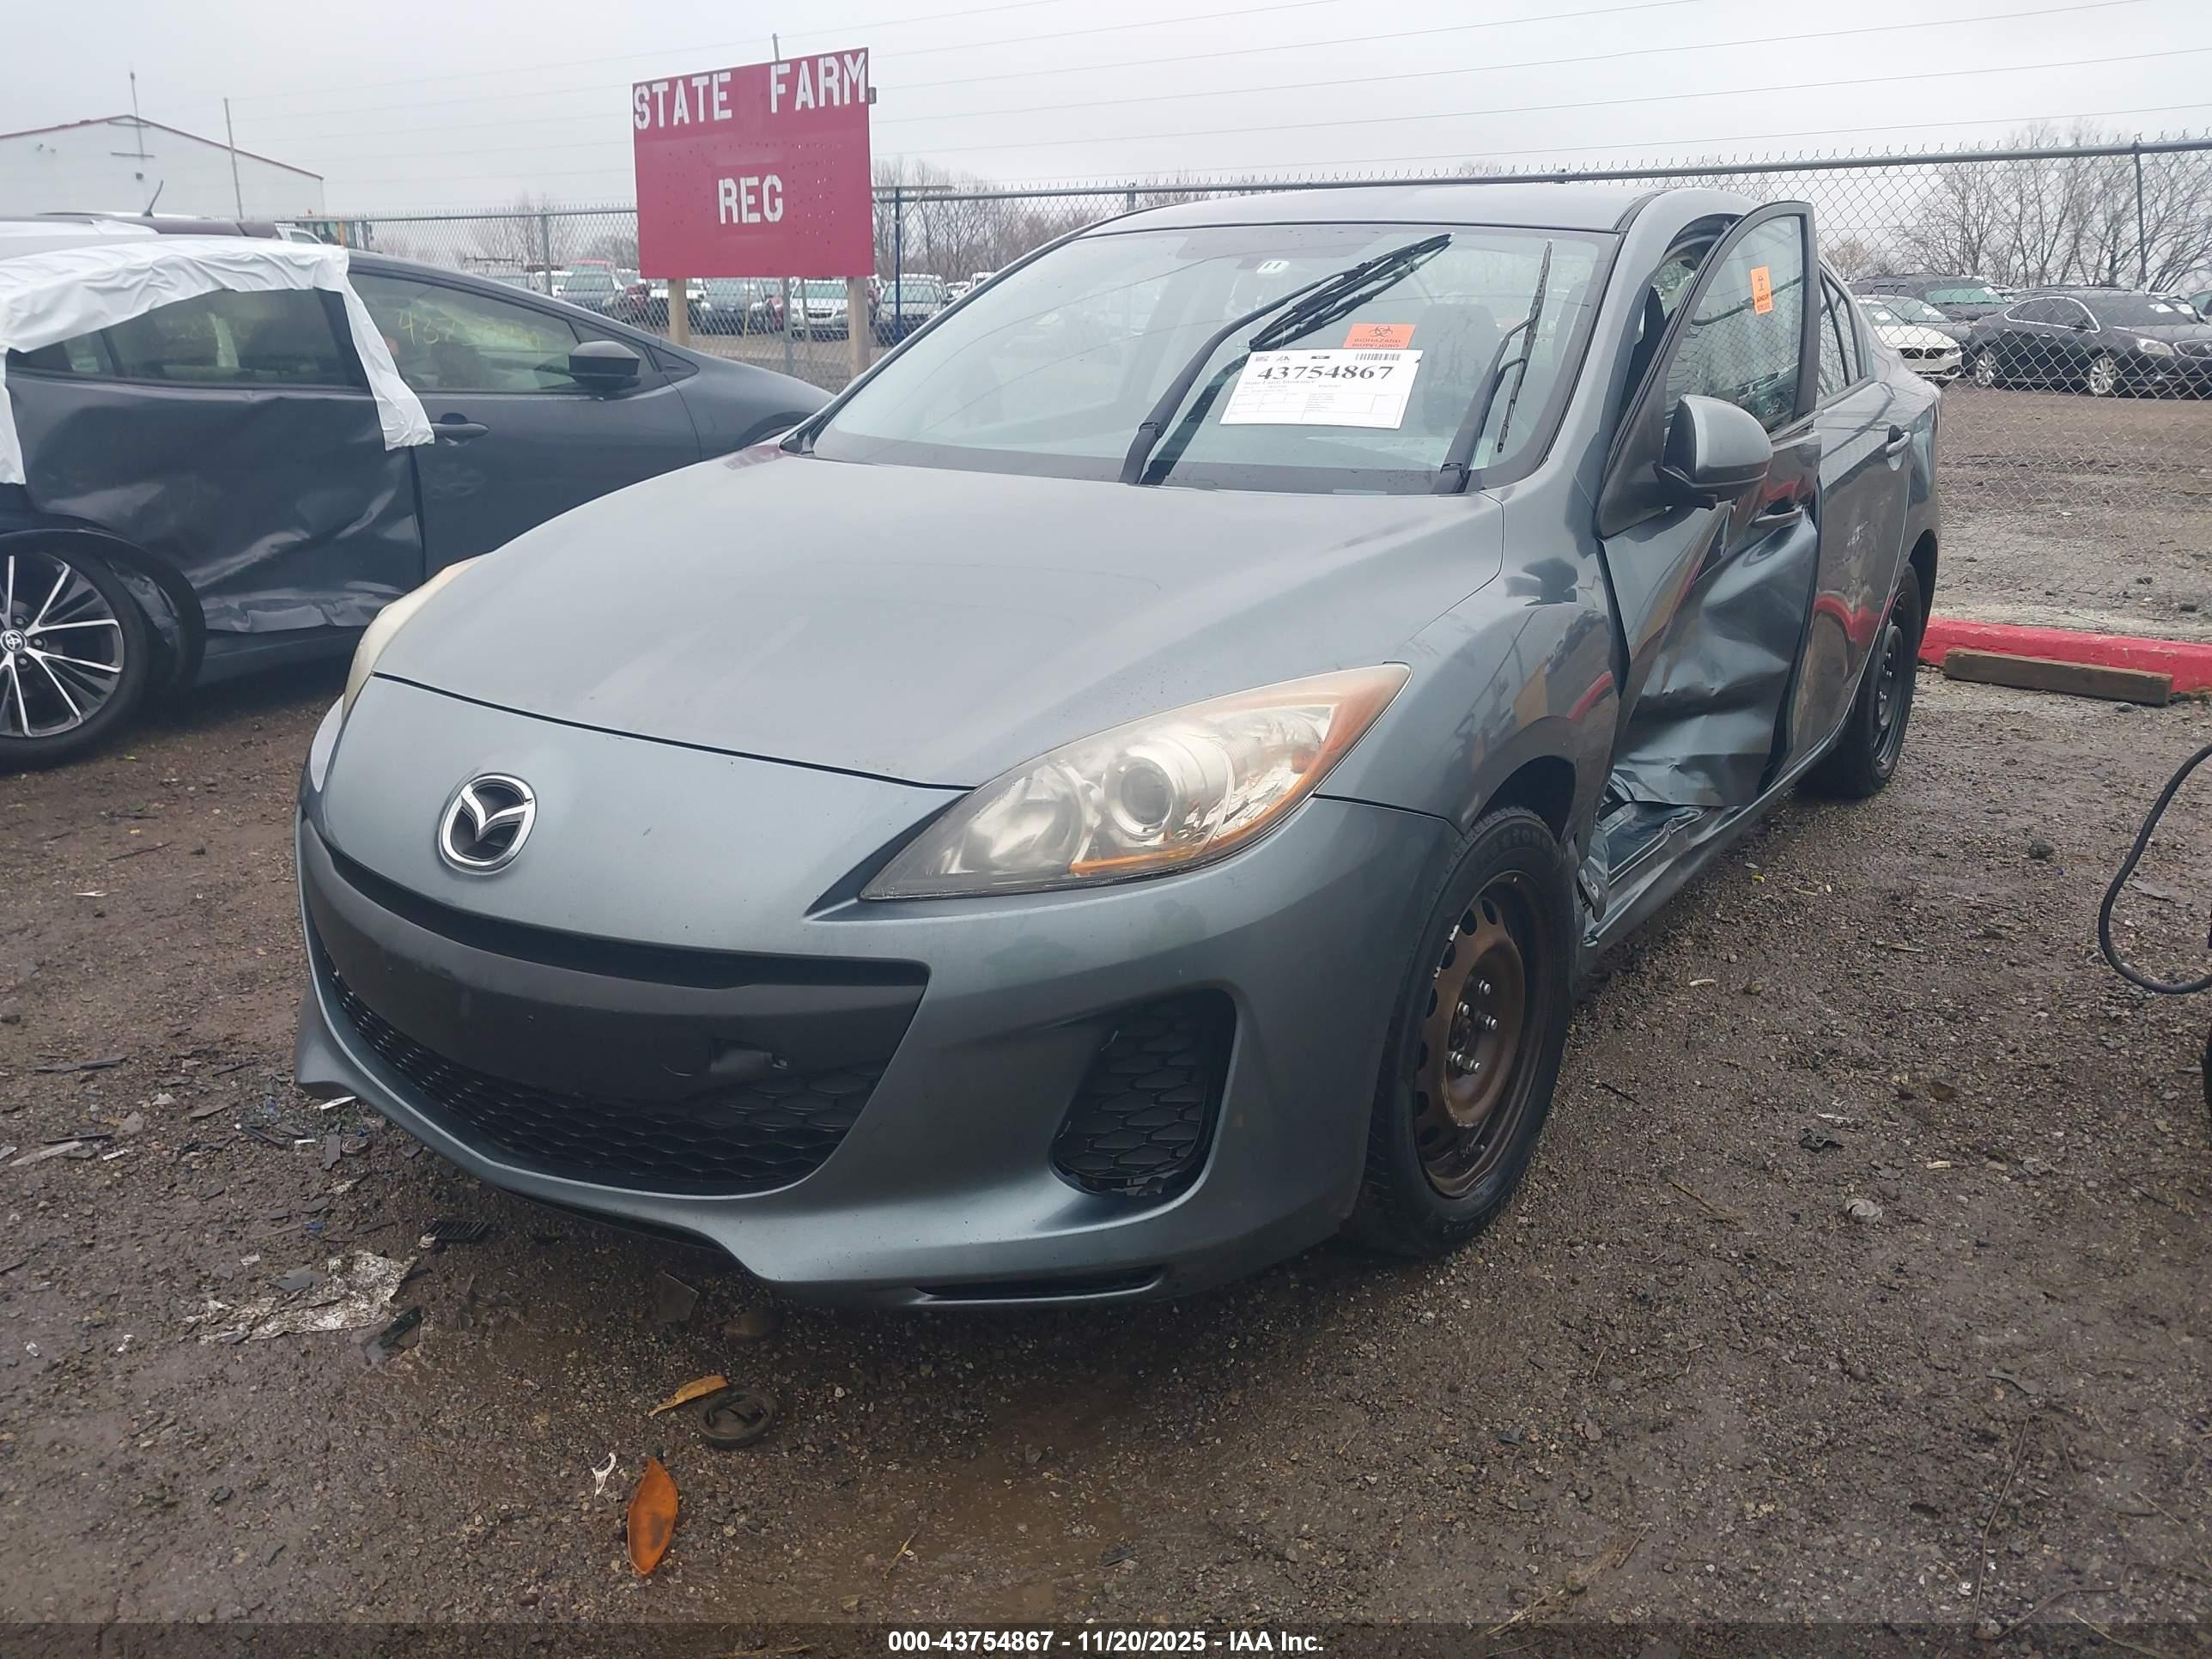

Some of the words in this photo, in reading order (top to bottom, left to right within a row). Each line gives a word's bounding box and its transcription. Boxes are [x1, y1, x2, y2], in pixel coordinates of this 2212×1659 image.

[634, 72, 732, 129] STATE
[770, 52, 866, 113] FARM
[718, 174, 783, 224] REG
[1256, 365, 1394, 380] 43754867
